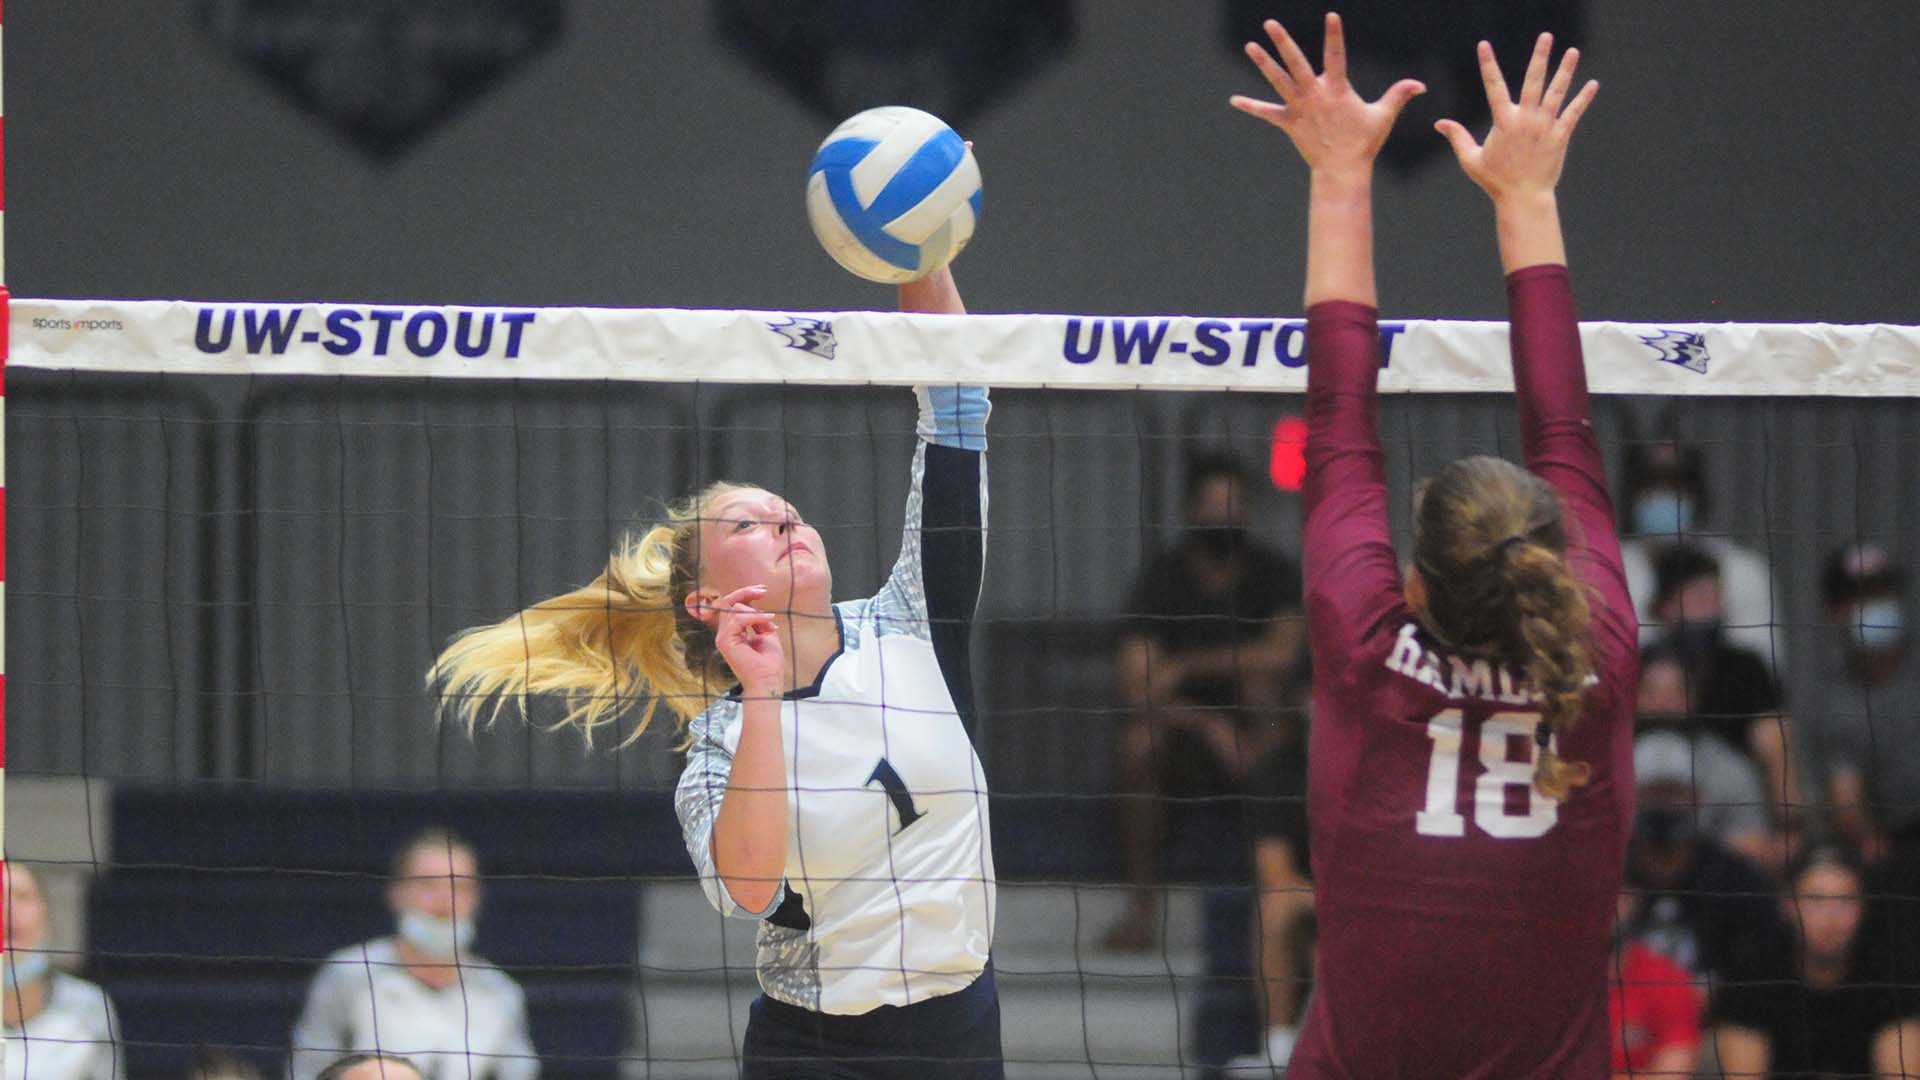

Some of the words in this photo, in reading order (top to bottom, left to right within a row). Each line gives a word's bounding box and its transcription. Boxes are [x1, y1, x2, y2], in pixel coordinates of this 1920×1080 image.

[32, 318, 72, 330] sports
[194, 308, 535, 357] UW-STOUT
[1063, 318, 1406, 368] UW-STOT
[864, 757, 928, 837] 1
[1416, 708, 1558, 838] 18
